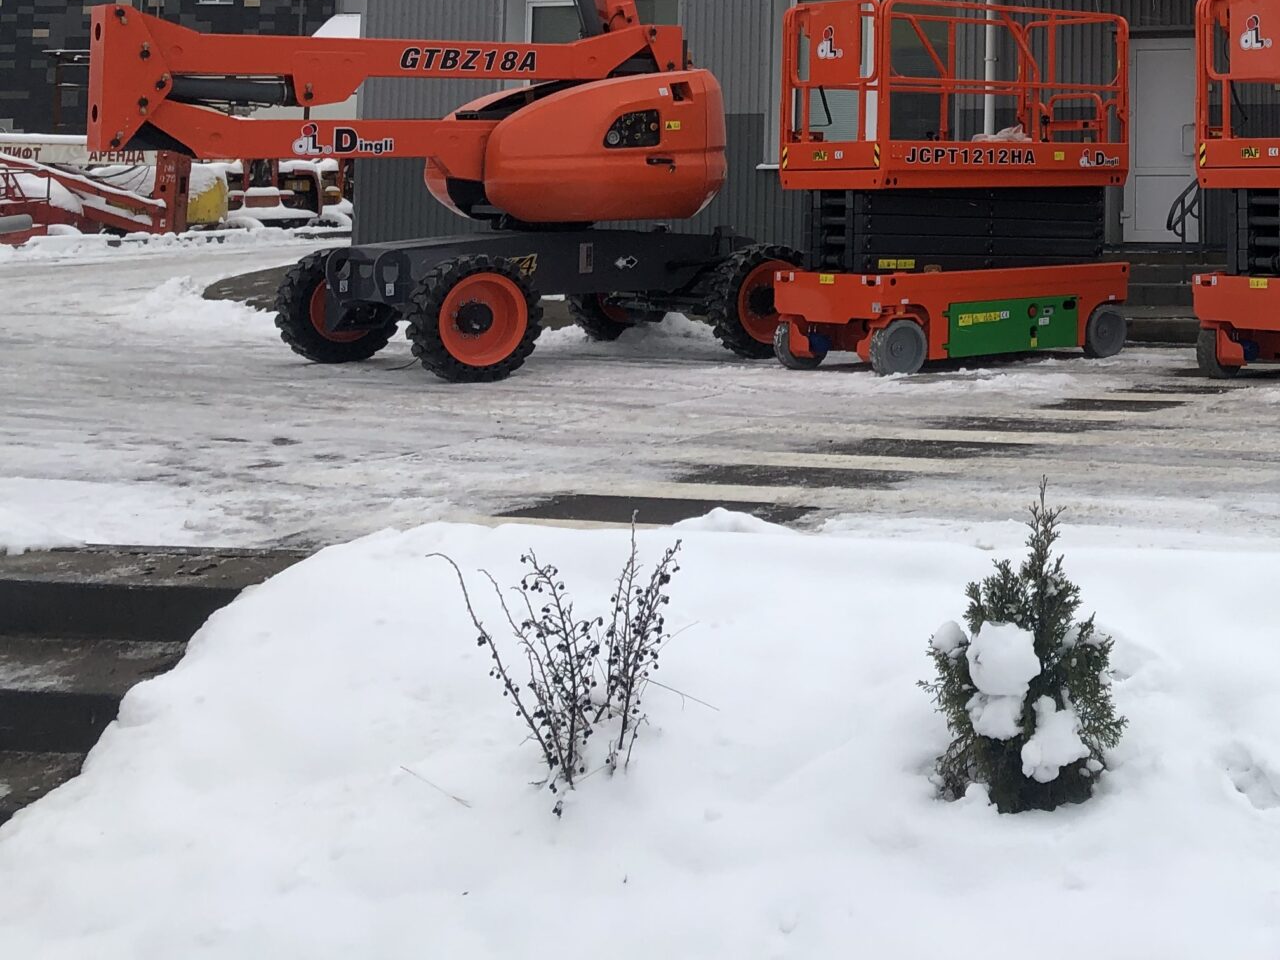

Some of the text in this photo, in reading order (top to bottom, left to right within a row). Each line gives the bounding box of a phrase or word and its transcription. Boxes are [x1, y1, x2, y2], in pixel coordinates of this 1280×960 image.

[400, 46, 537, 72] GTBZ18A
[333, 127, 394, 155] Dingli
[0, 146, 145, 164] ЛИФТ АРЕНДА
[905, 146, 1036, 165] JCPT1212HA
[1241, 146, 1260, 158] IPAF
